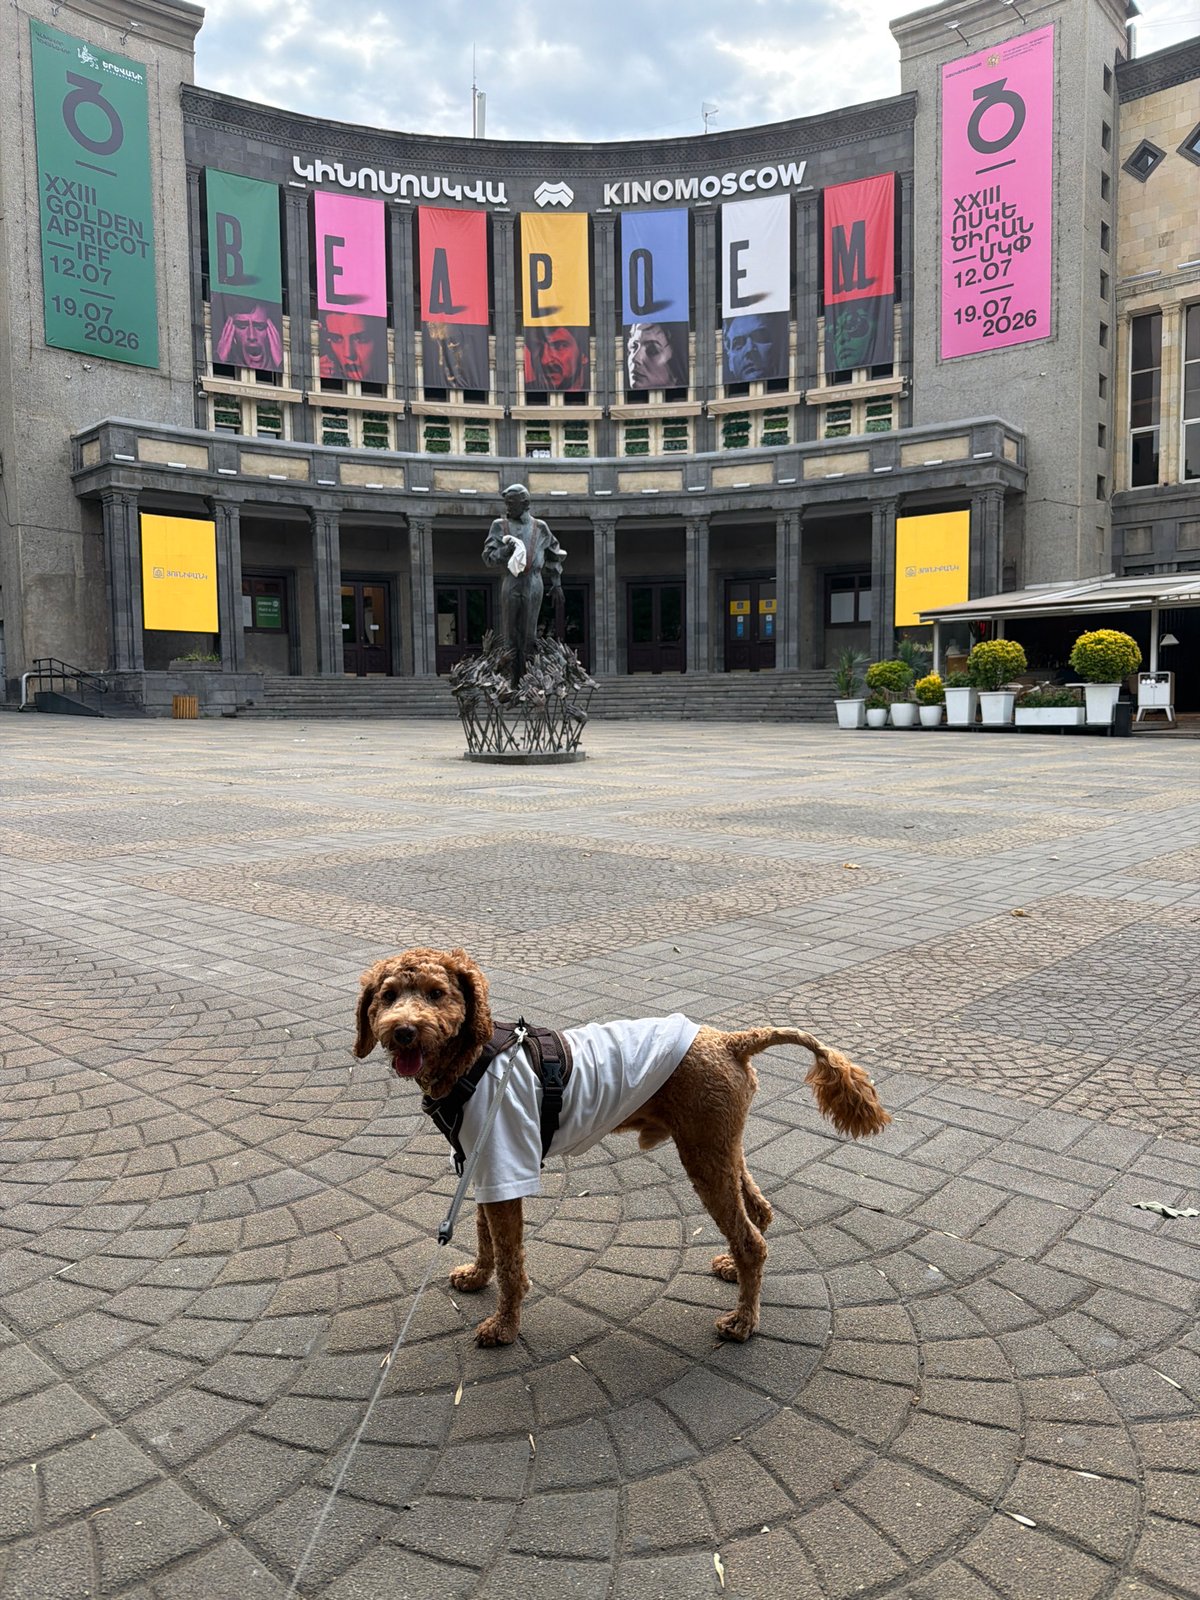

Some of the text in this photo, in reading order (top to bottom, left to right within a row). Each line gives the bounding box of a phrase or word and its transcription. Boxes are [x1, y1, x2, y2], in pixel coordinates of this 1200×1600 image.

[45, 172, 97, 206] XXIII
[293, 155, 508, 204] ԿԻՆՈՄՈՍԿՎԱ
[604, 161, 807, 206] KINOMOSCOW
[953, 184, 1000, 215] XXIII
[46, 194, 143, 239] GOLDEN
[953, 202, 1017, 234] ՈՍԿԵ
[47, 215, 150, 259] APRICOT
[951, 216, 1034, 252] ԾԻՐԱՆ
[50, 255, 112, 286] 12.07
[324, 234, 345, 305] E
[429, 247, 453, 315] A
[529, 253, 552, 318] P
[730, 239, 751, 309] E
[832, 220, 866, 294] M
[954, 258, 1012, 288] 12.07
[52, 295, 113, 325] 19.07
[954, 296, 1012, 325] 19.07
[982, 309, 1037, 337] 2026
[84, 322, 139, 350] 2026
